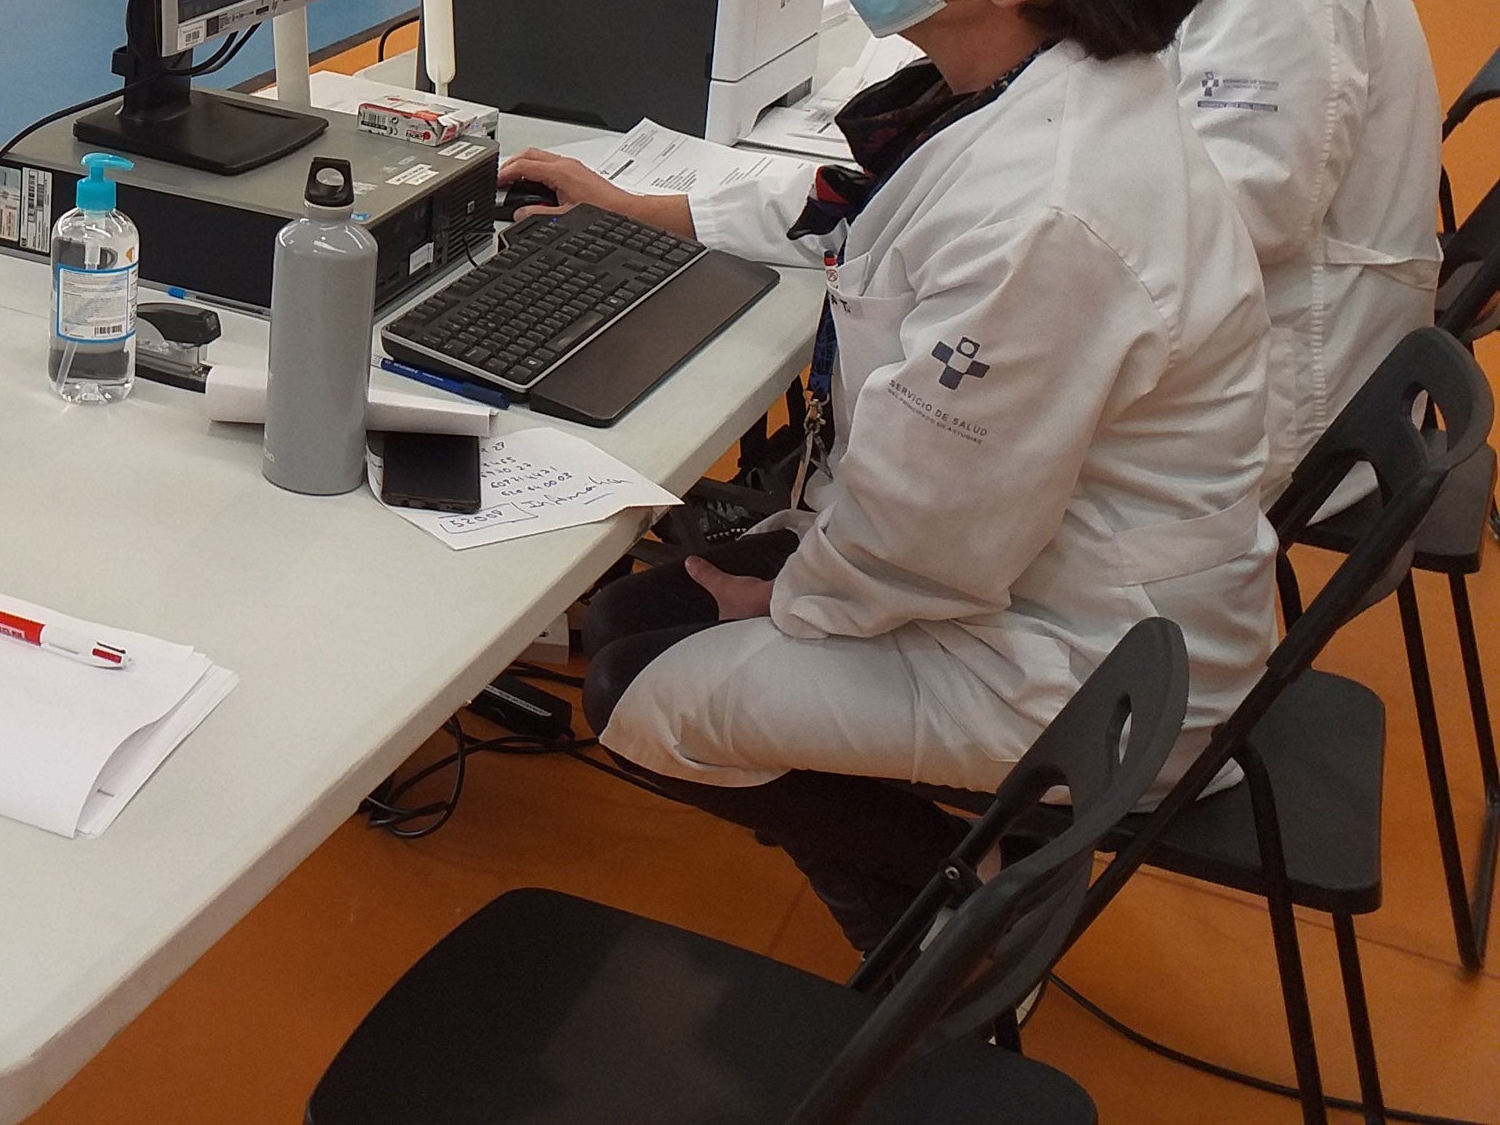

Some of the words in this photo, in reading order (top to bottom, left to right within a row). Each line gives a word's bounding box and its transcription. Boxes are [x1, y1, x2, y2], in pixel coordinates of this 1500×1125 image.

[889, 379, 933, 412] SERVICIO
[935, 409, 949, 422] DE
[952, 417, 988, 437] SALUD
